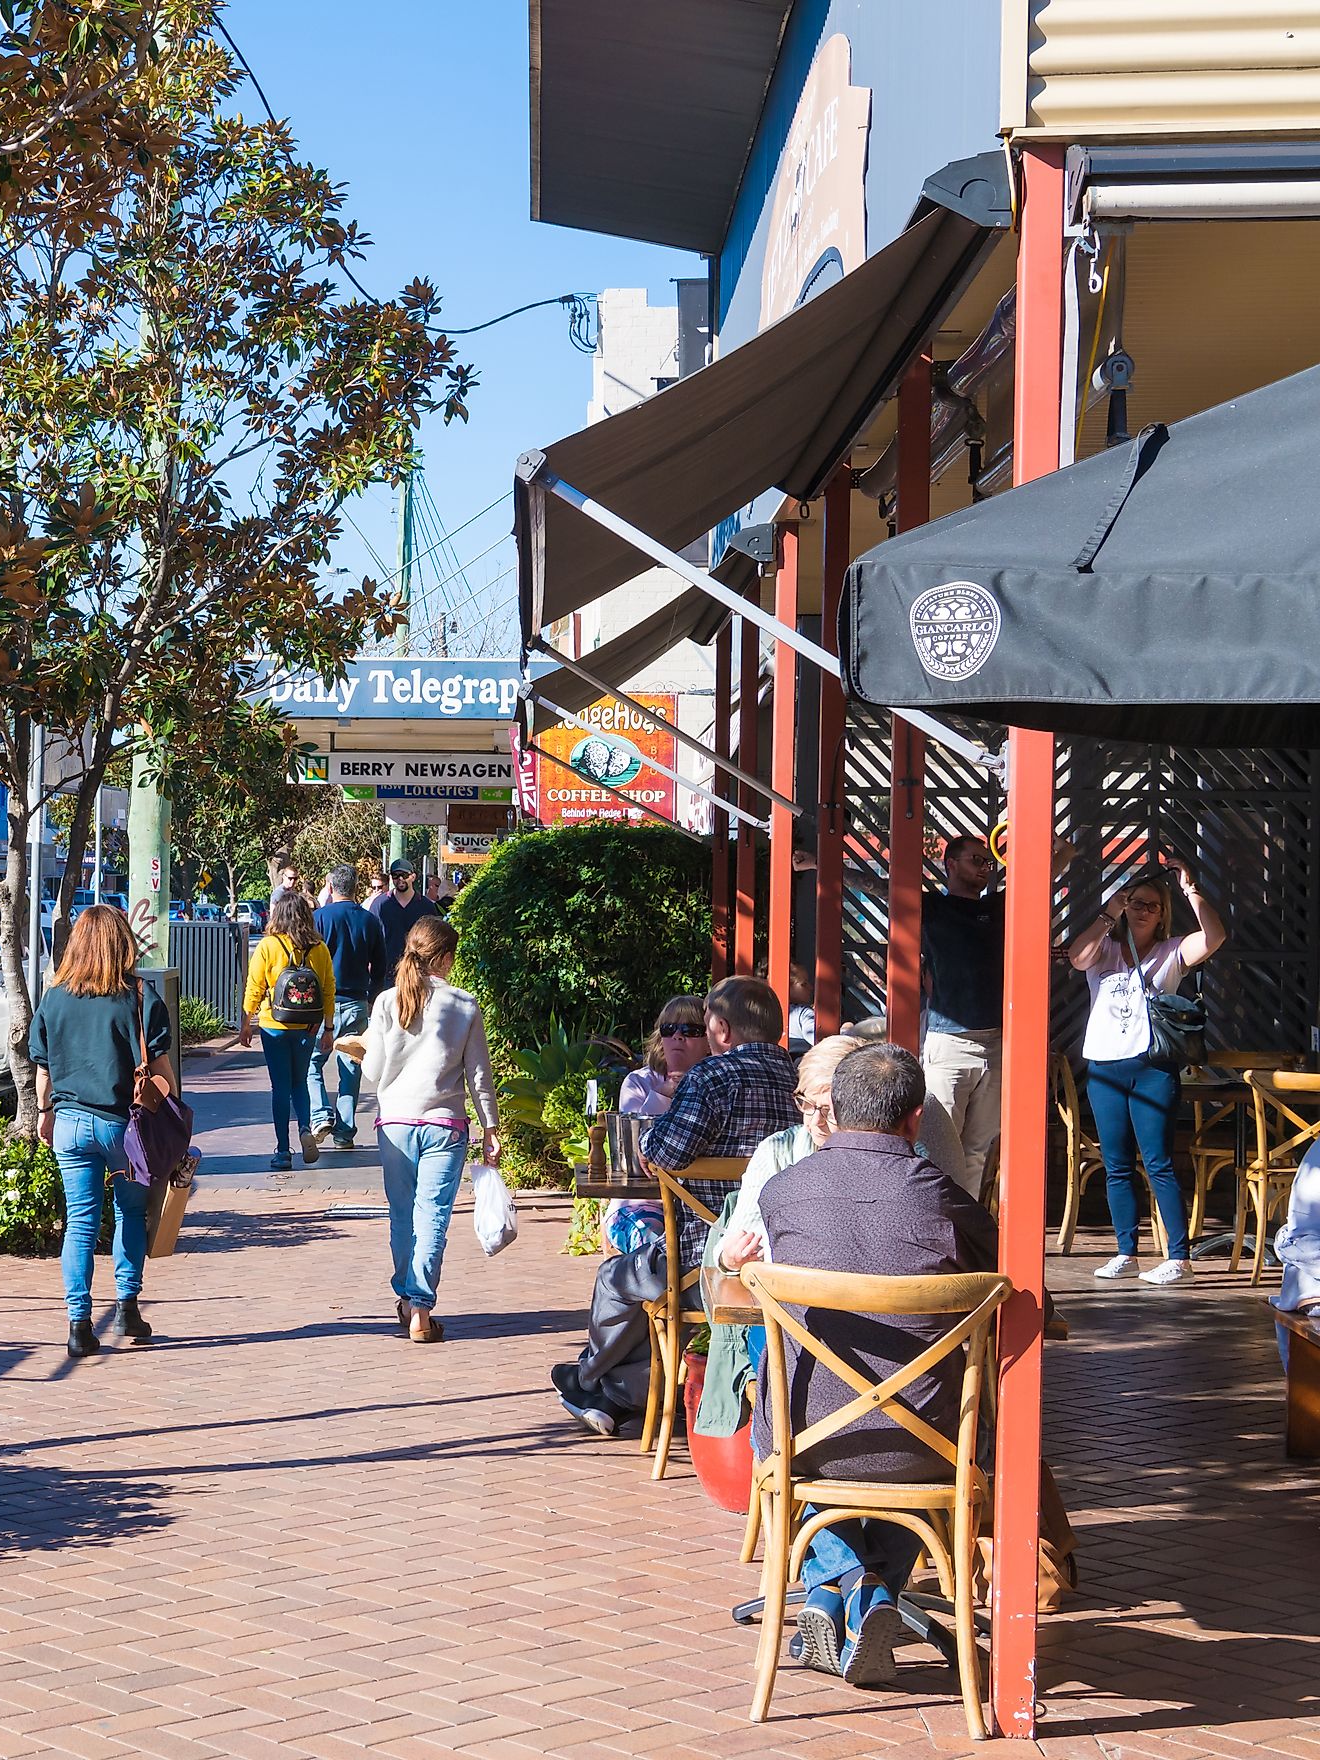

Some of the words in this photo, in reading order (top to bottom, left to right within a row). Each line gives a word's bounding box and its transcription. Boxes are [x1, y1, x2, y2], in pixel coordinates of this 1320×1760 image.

[915, 621, 993, 636] GIANCARLO
[932, 633, 969, 642] COFFEE
[267, 668, 361, 713] Daily
[340, 762, 395, 776] BERRY
[405, 762, 514, 779] NEWSAGEN
[404, 785, 474, 797] Lotteries
[547, 789, 612, 803] COFFEE
[617, 789, 667, 803] SHOP
[561, 808, 586, 818] Behind
